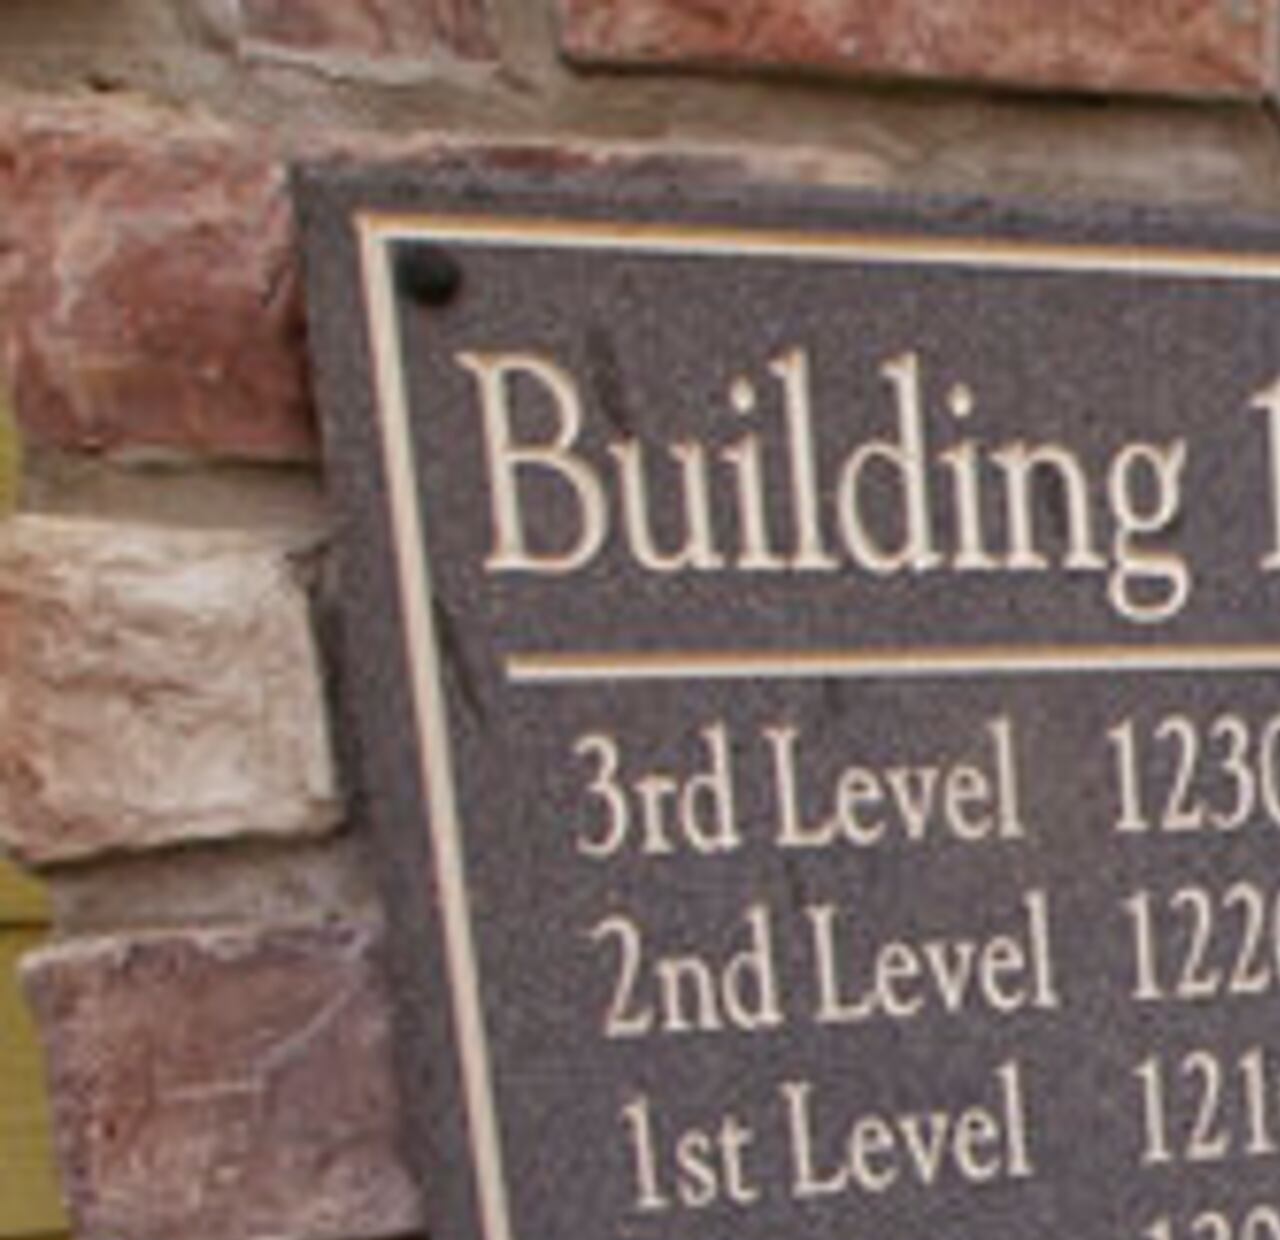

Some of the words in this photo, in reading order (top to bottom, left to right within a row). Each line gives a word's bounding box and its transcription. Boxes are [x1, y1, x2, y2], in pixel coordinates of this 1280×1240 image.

[456, 350, 1192, 624] Building
[574, 723, 742, 857] 3rd
[764, 716, 1024, 848] Level
[591, 904, 784, 1038] 2nd
[807, 889, 1059, 1023] Level
[623, 1098, 757, 1210] 1st
[782, 1060, 1032, 1197] Level
